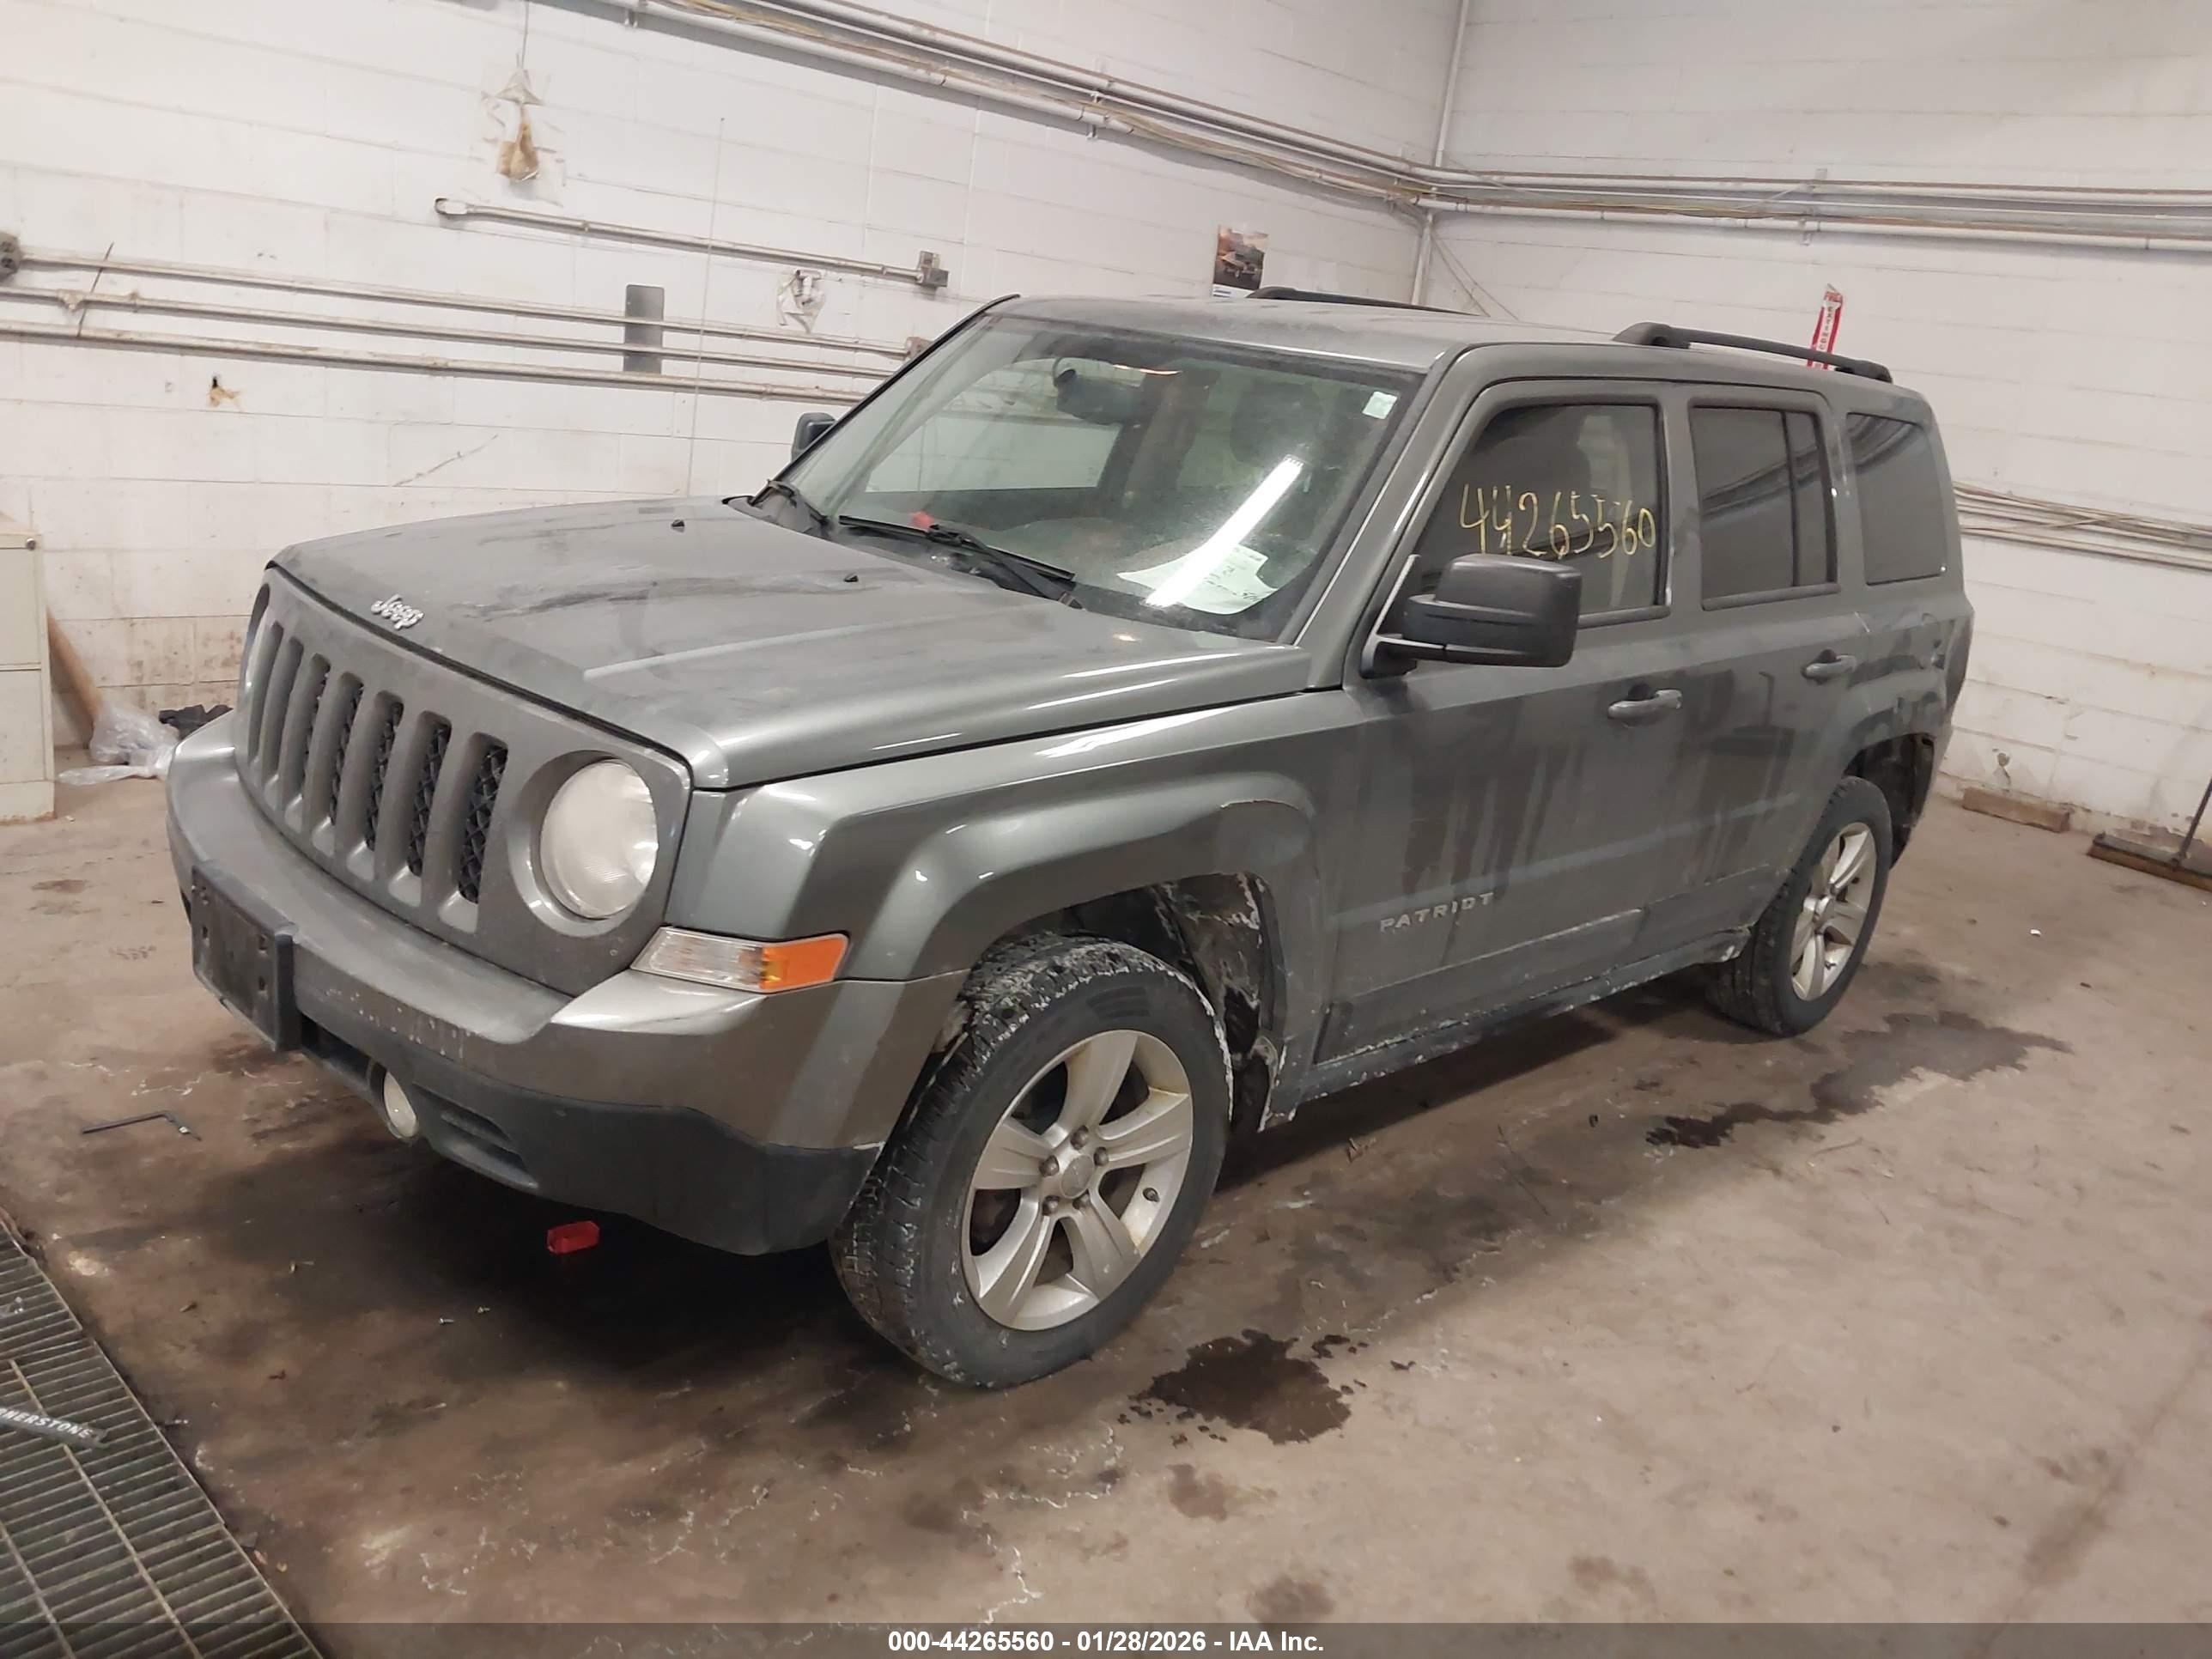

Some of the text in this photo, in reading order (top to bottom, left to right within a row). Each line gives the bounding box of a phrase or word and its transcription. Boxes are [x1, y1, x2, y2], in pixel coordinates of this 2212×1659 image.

[1460, 483, 1656, 559] 44265560
[370, 593, 424, 629] Jeep
[1380, 892, 1494, 933] PATRIOT
